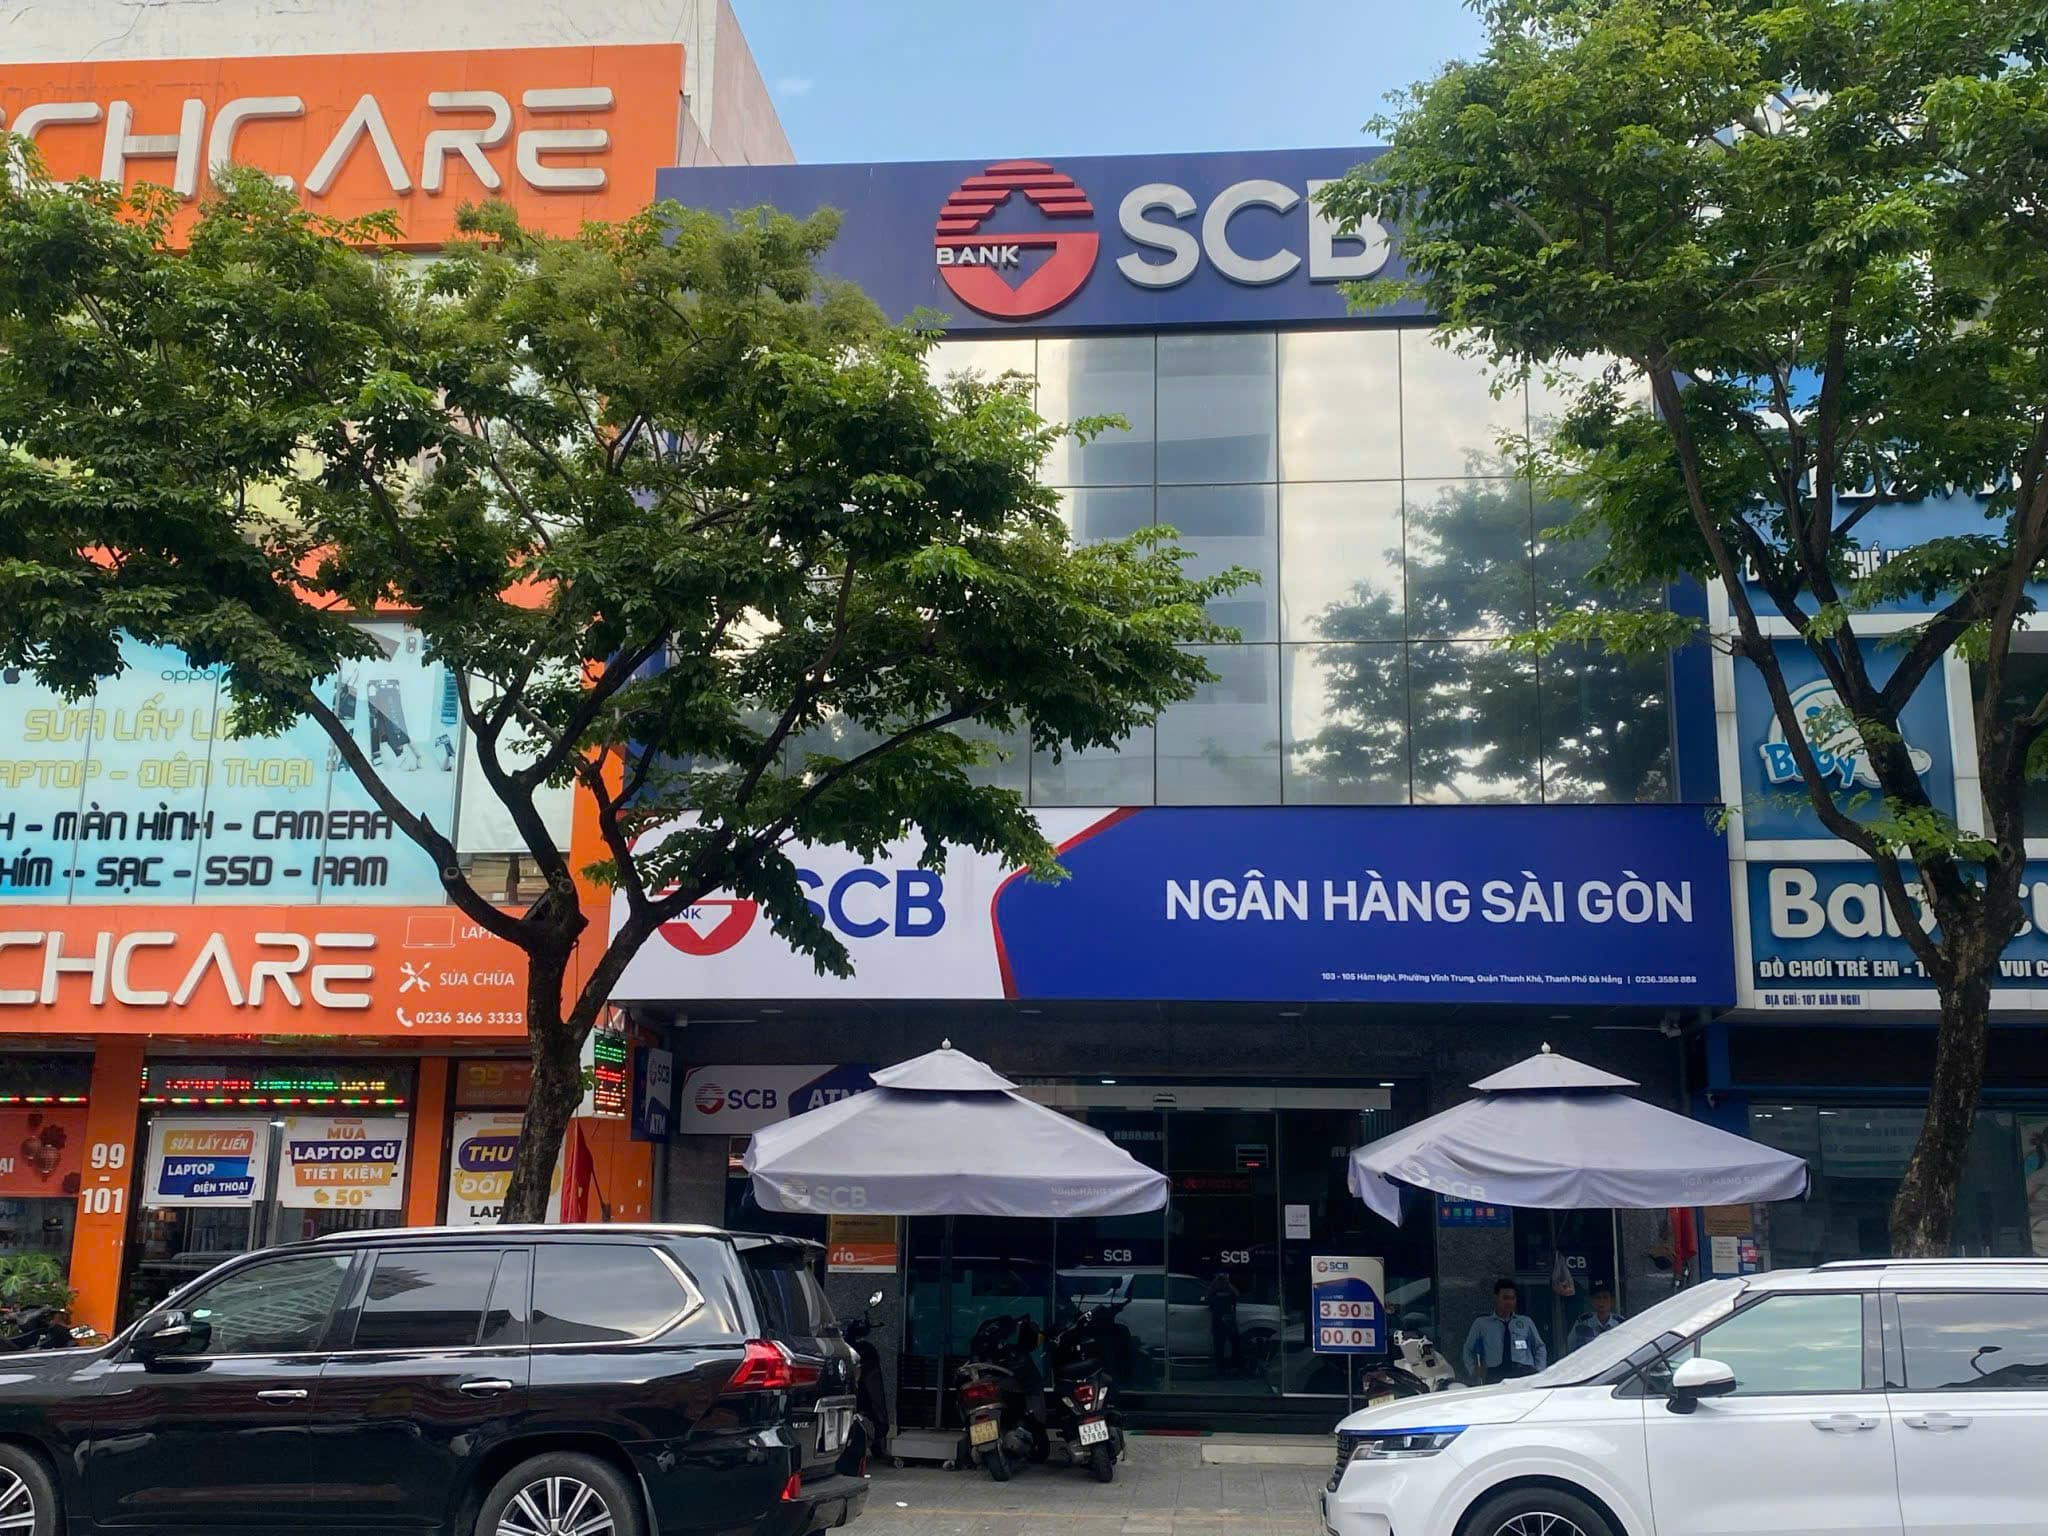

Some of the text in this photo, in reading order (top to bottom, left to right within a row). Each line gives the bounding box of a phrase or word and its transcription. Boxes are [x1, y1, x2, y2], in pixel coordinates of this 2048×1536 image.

[0, 87, 615, 196] CHCARE
[1117, 179, 1391, 288] SCB
[936, 244, 1019, 266] BANK
[161, 670, 217, 684] oppo
[24, 697, 105, 742] SỬA
[113, 692, 184, 742] LẤY
[138, 751, 214, 793] ĐIỆN
[223, 758, 313, 794] THOẠI
[53, 801, 127, 841] MÀN
[136, 801, 214, 841] HÌNH
[253, 811, 393, 840] CAMERA
[95, 857, 164, 894] SẠC
[204, 856, 273, 886] SSD
[313, 856, 388, 886] RAM
[1166, 869, 1693, 923] NGÂN HÀNG SÀI GÒN
[1760, 955, 1785, 978] ĐỒ
[1788, 957, 1833, 977] CHƠI
[1835, 956, 1868, 977] TRẺ
[1873, 961, 1899, 977] EM
[2000, 961, 2031, 977] VUI
[416, 1012, 522, 1024] 0236 366 3333
[728, 1089, 777, 1110] SCB
[327, 1128, 366, 1139] MUA
[91, 1143, 125, 1169] 99
[294, 1142, 396, 1160] LAPTOP CŨ
[468, 1146, 513, 1162] THU
[168, 1163, 215, 1176] LAPTOP
[343, 1165, 383, 1183] KIỆM
[219, 1181, 249, 1193] THOẠI
[815, 1186, 866, 1209] SCB
[82, 1188, 123, 1214] 101
[1104, 1249, 1132, 1262] SCB
[1221, 1251, 1250, 1263] SCB
[1329, 1261, 1349, 1270] SCB
[1321, 1303, 1361, 1317] 3.90
